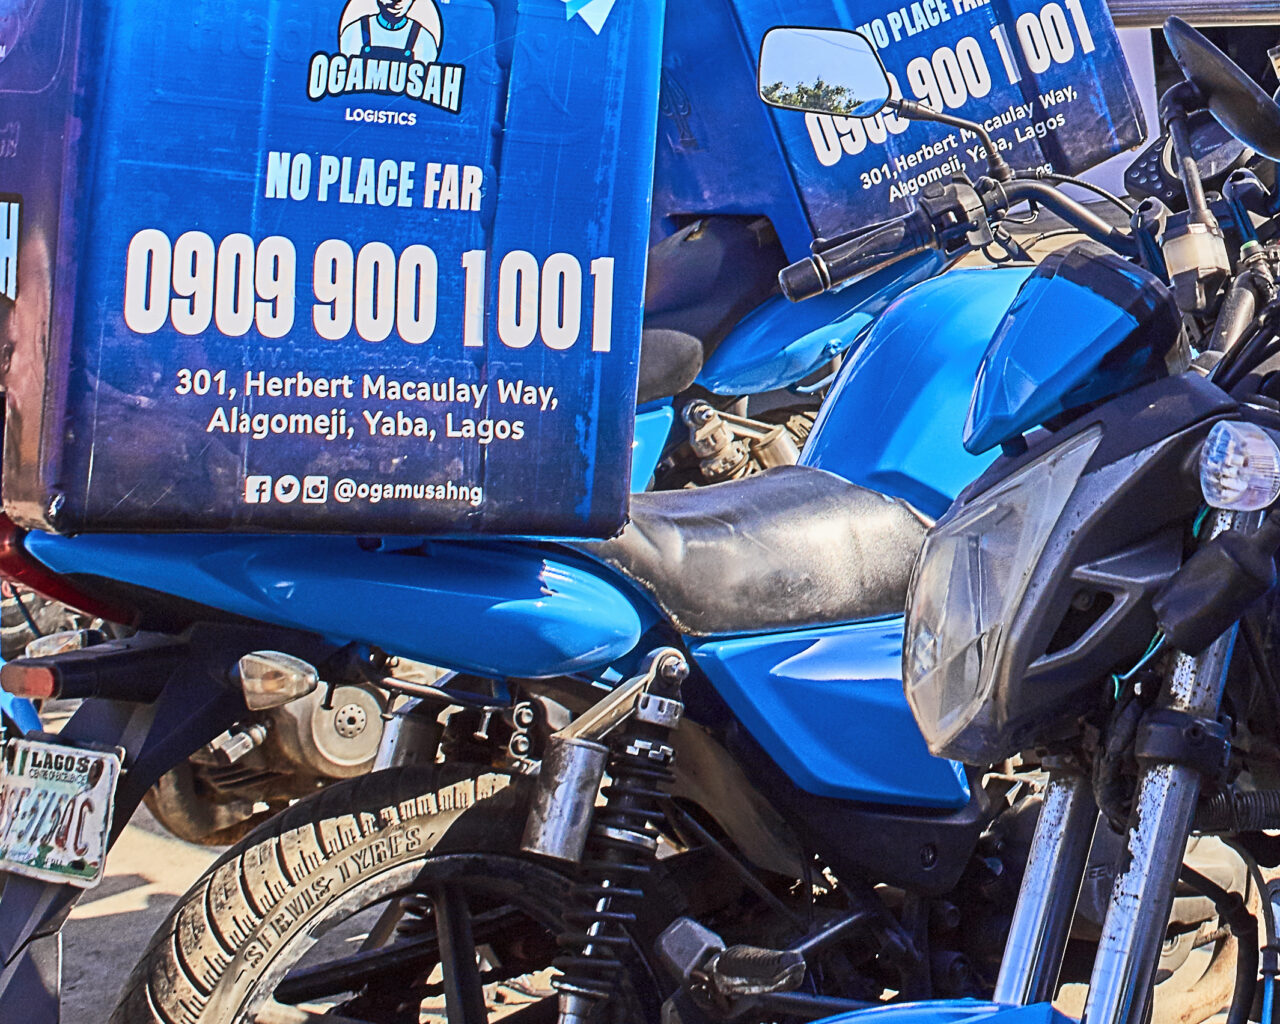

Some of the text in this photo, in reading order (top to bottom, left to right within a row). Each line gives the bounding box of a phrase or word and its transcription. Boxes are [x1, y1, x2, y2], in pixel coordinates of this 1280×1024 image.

[309, 55, 463, 112] OGAMUSAH
[907, 36, 992, 116] 900
[345, 107, 417, 127] LOGISTICS
[896, 134, 958, 172] Herbert
[1039, 85, 1078, 110] Way,
[1014, 112, 1066, 144] Lagos
[265, 152, 484, 211] NO PLACE FAR
[123, 229, 297, 340] 0909
[312, 239, 439, 344] 900
[175, 367, 559, 410] 301, Herbert Macaulay Way,
[207, 407, 525, 446] Alagomeji, Yaba, Lagos
[334, 479, 484, 505] @ogamusahng
[31, 752, 90, 774] LAGOS
[335, 826, 422, 884] TYRES
